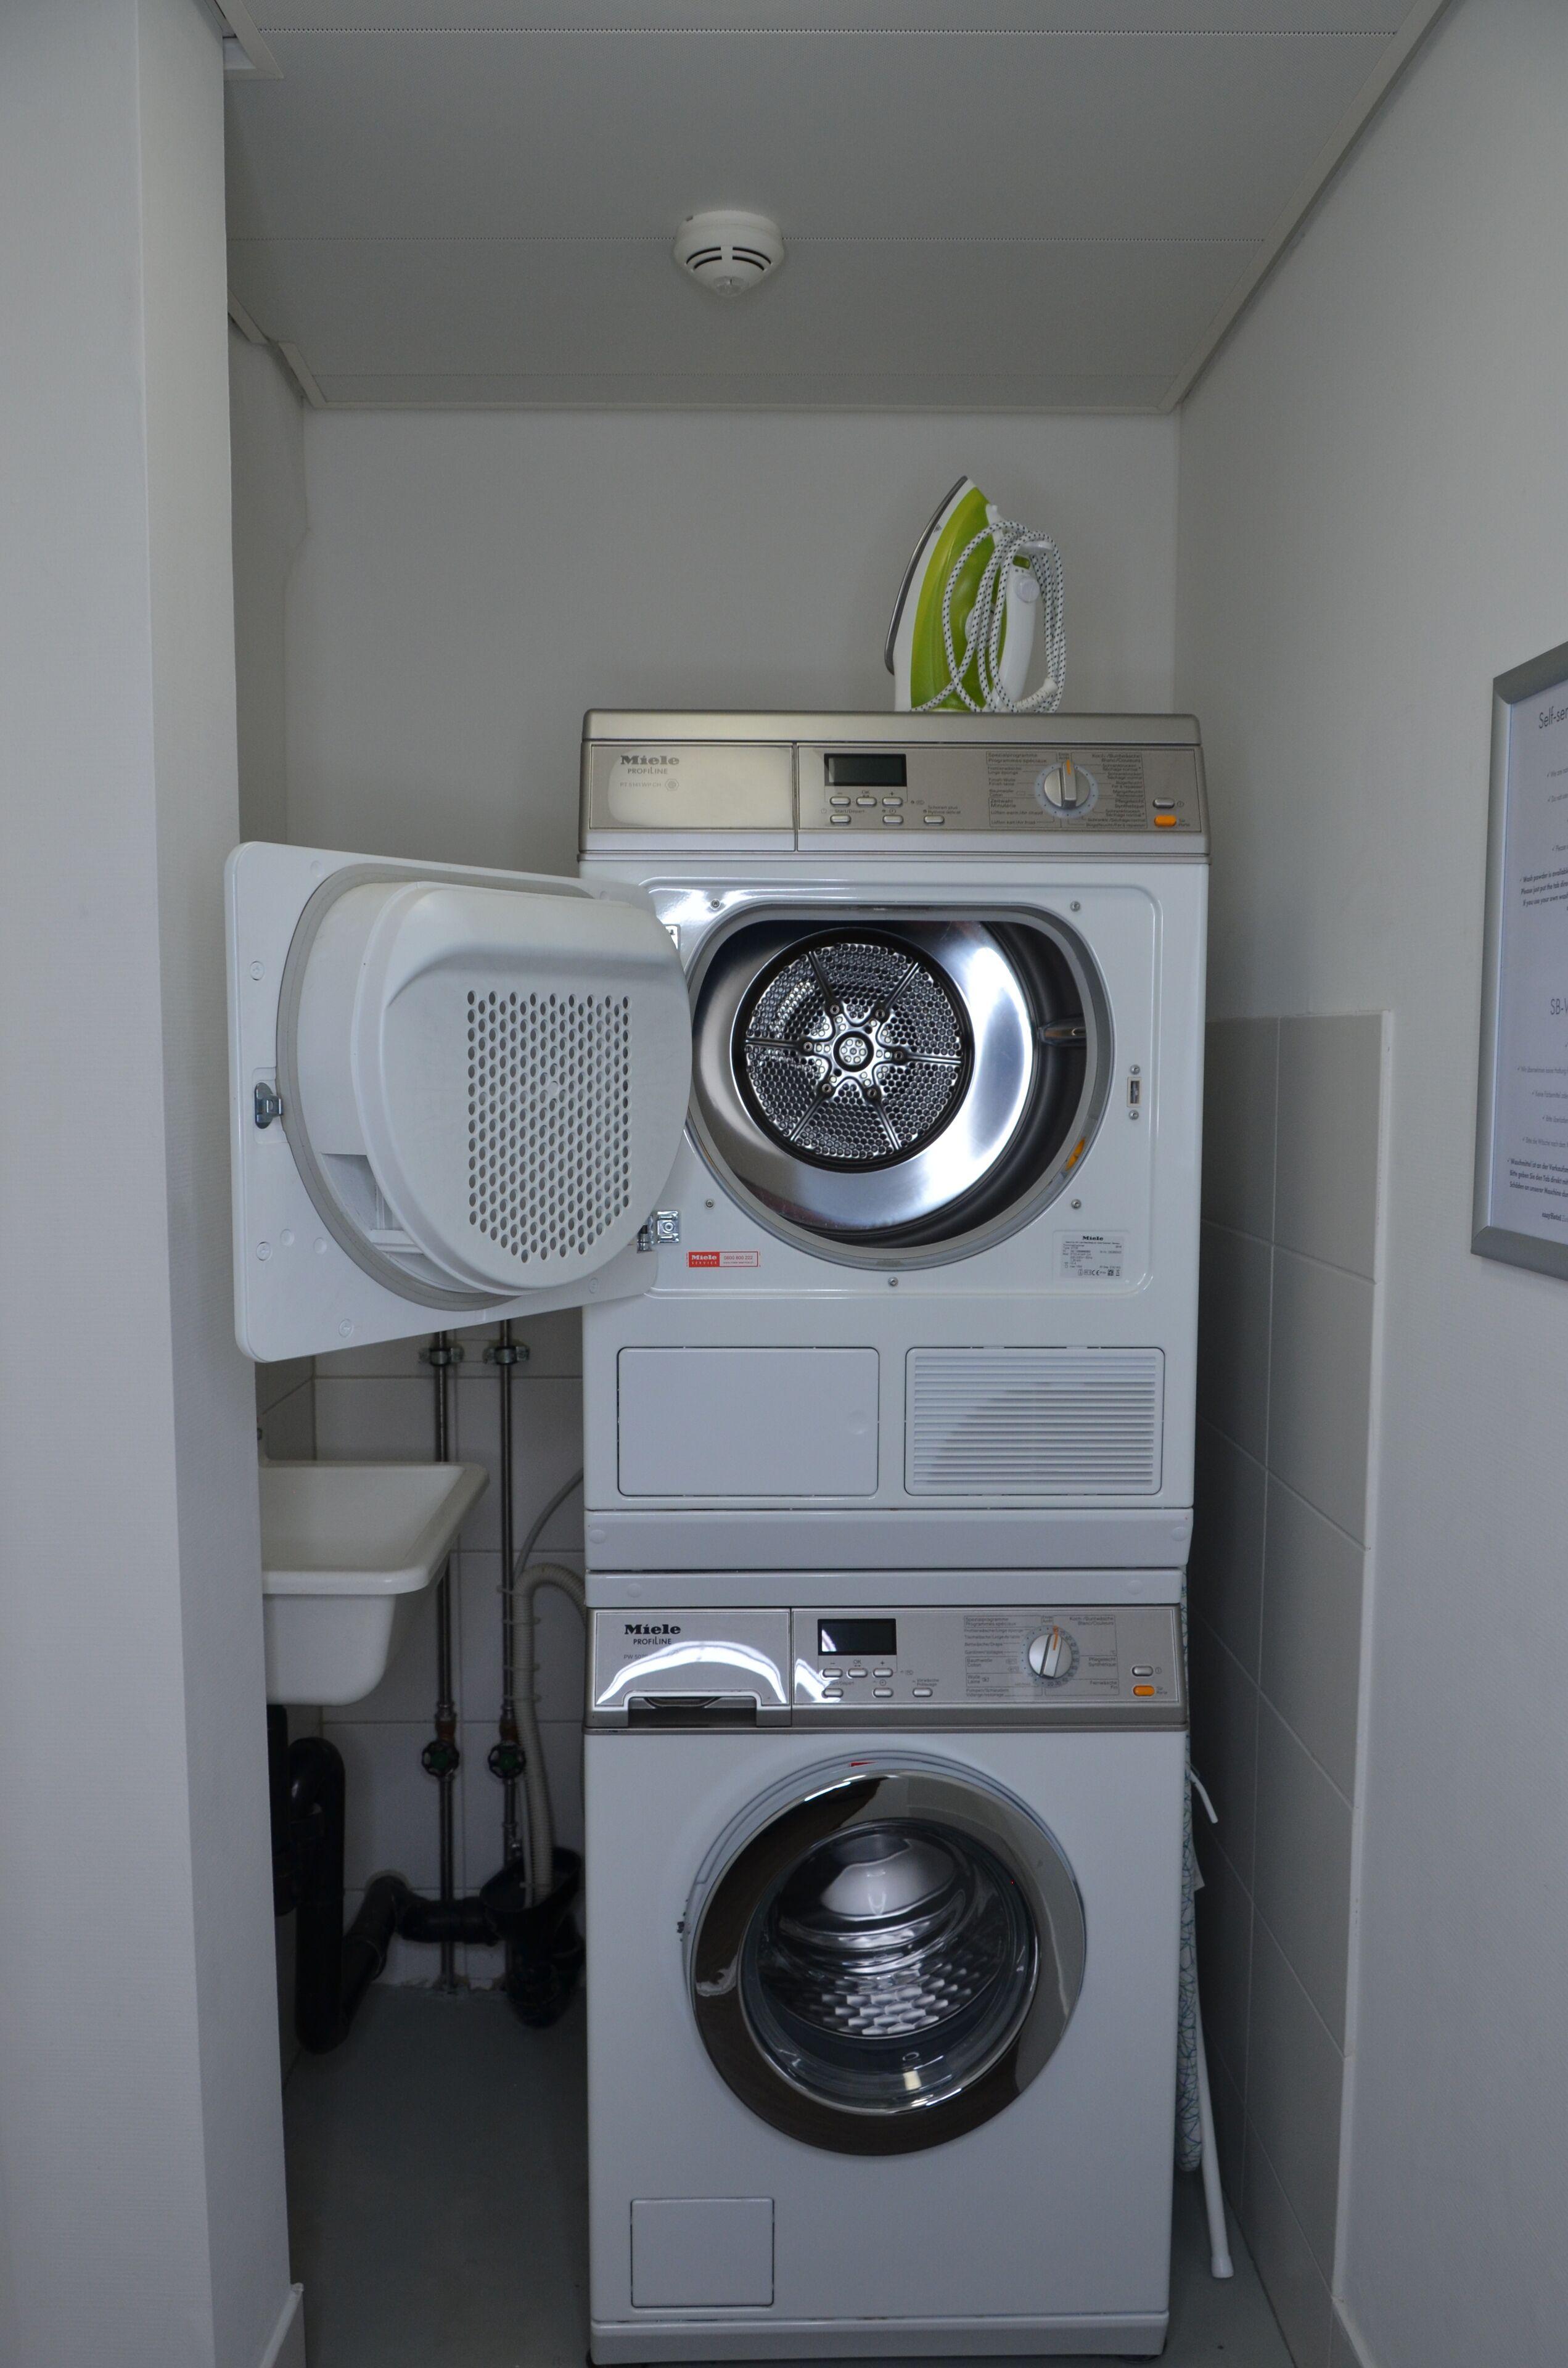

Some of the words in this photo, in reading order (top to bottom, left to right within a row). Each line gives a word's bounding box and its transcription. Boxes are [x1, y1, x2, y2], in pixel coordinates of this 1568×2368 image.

[620, 755, 679, 765] Miele
[628, 767, 668, 775] PROFILINE
[625, 1624, 681, 1635] Miele
[633, 1636, 671, 1645] PROFILINE
